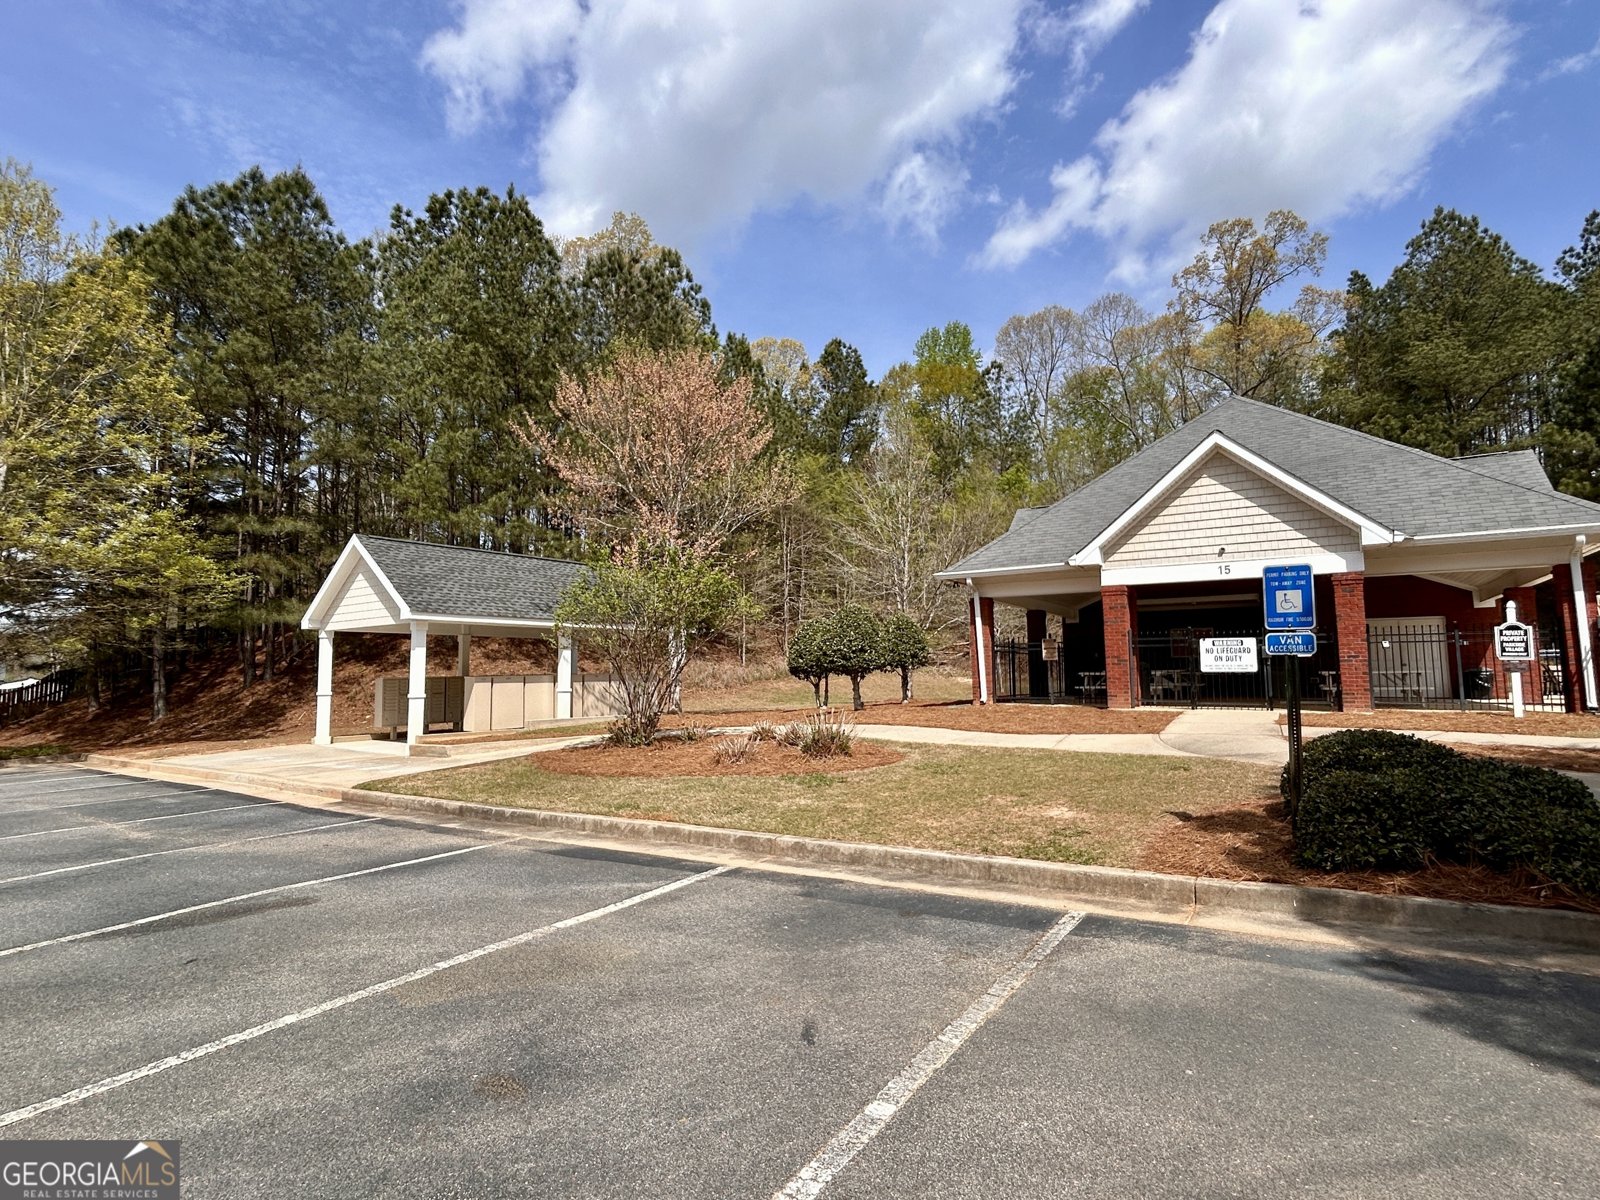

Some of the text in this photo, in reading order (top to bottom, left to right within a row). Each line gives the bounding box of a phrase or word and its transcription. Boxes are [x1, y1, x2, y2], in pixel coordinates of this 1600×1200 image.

[1218, 565, 1231, 575] 15
[1279, 635, 1302, 645] VAN
[1205, 646, 1252, 655] NO LIFEGUARD
[1269, 644, 1313, 652] ACCESSIBLE
[1225, 654, 1243, 662] DUTY
